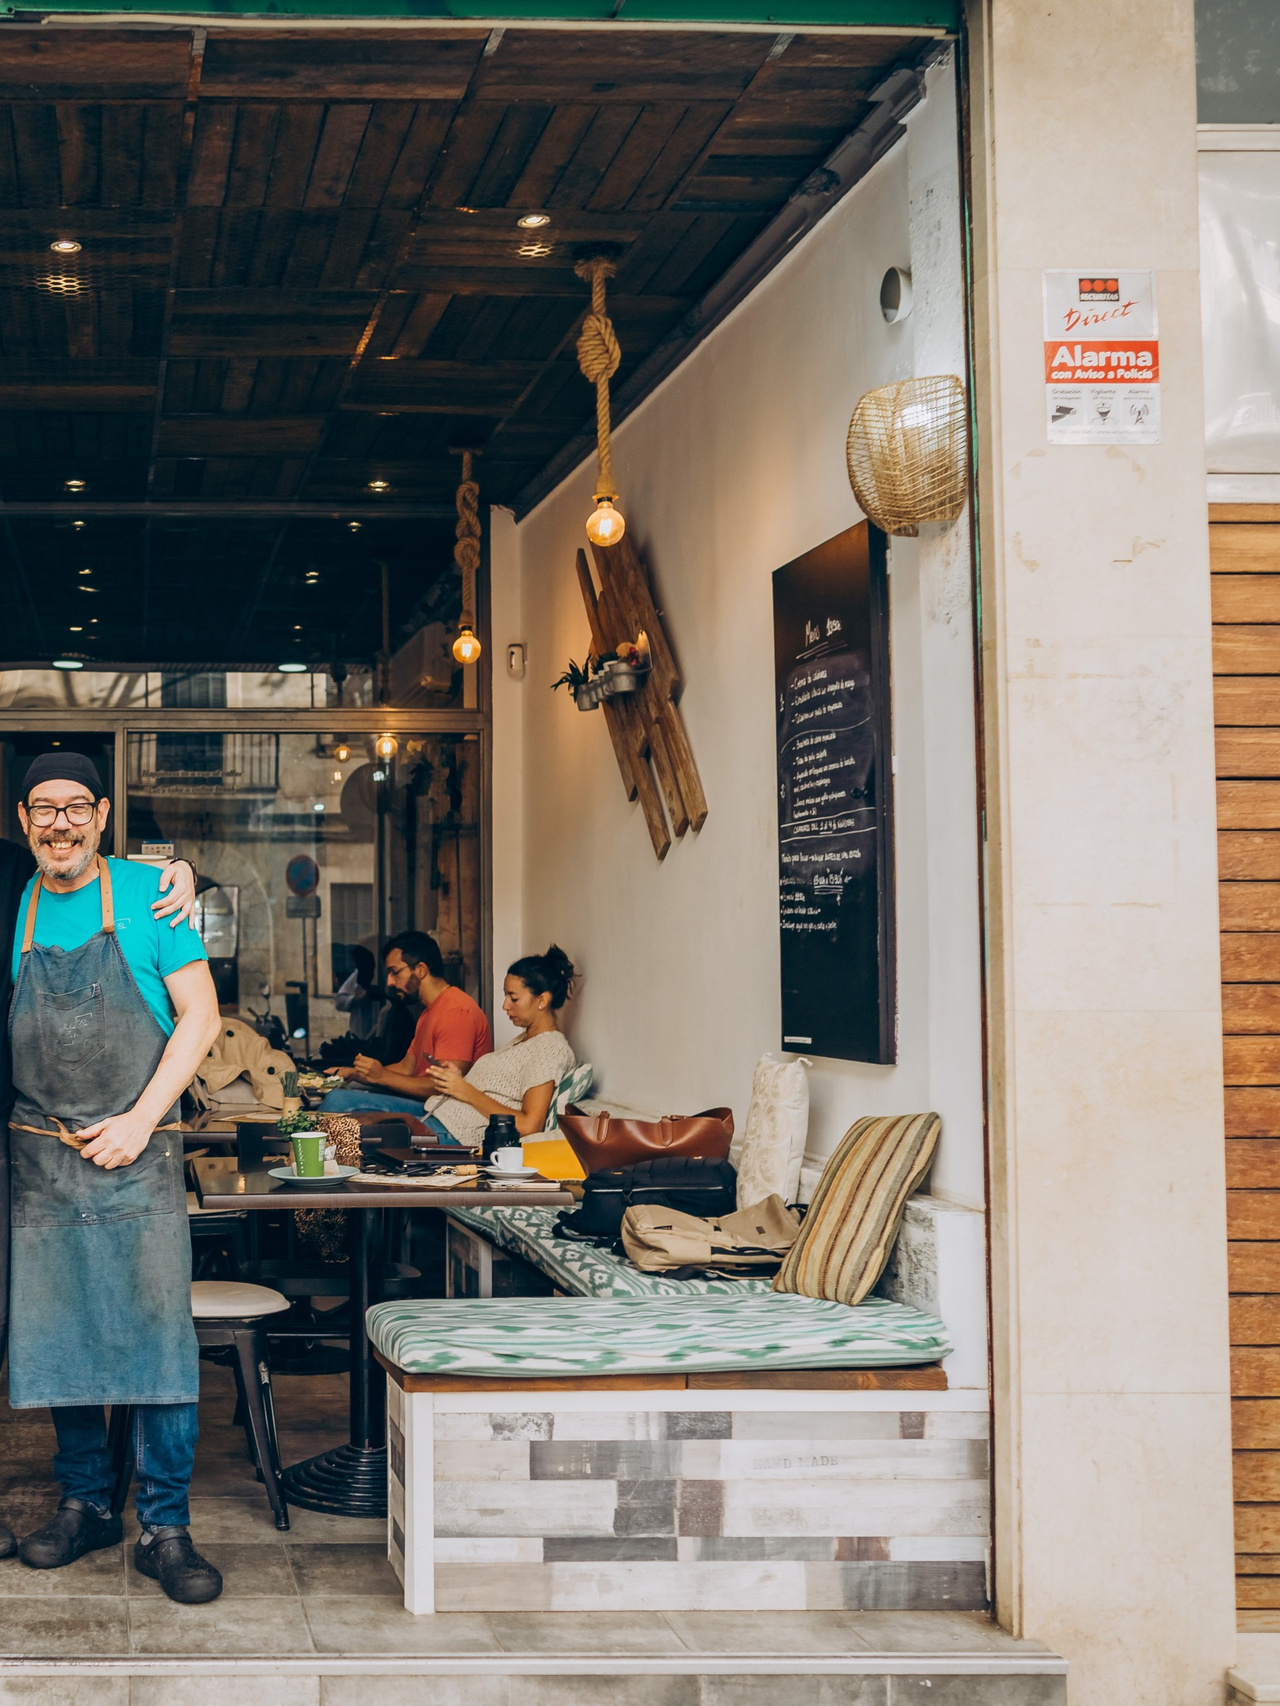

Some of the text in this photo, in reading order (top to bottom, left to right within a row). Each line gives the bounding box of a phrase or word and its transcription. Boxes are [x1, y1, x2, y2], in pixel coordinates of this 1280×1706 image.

[1062, 300, 1140, 332] Direct
[1051, 345, 1153, 367] Alarma
[1051, 368, 1153, 380] con Aviso a Policía
[142, 770, 179, 778] Happiness
[221, 769, 243, 777] coffee
